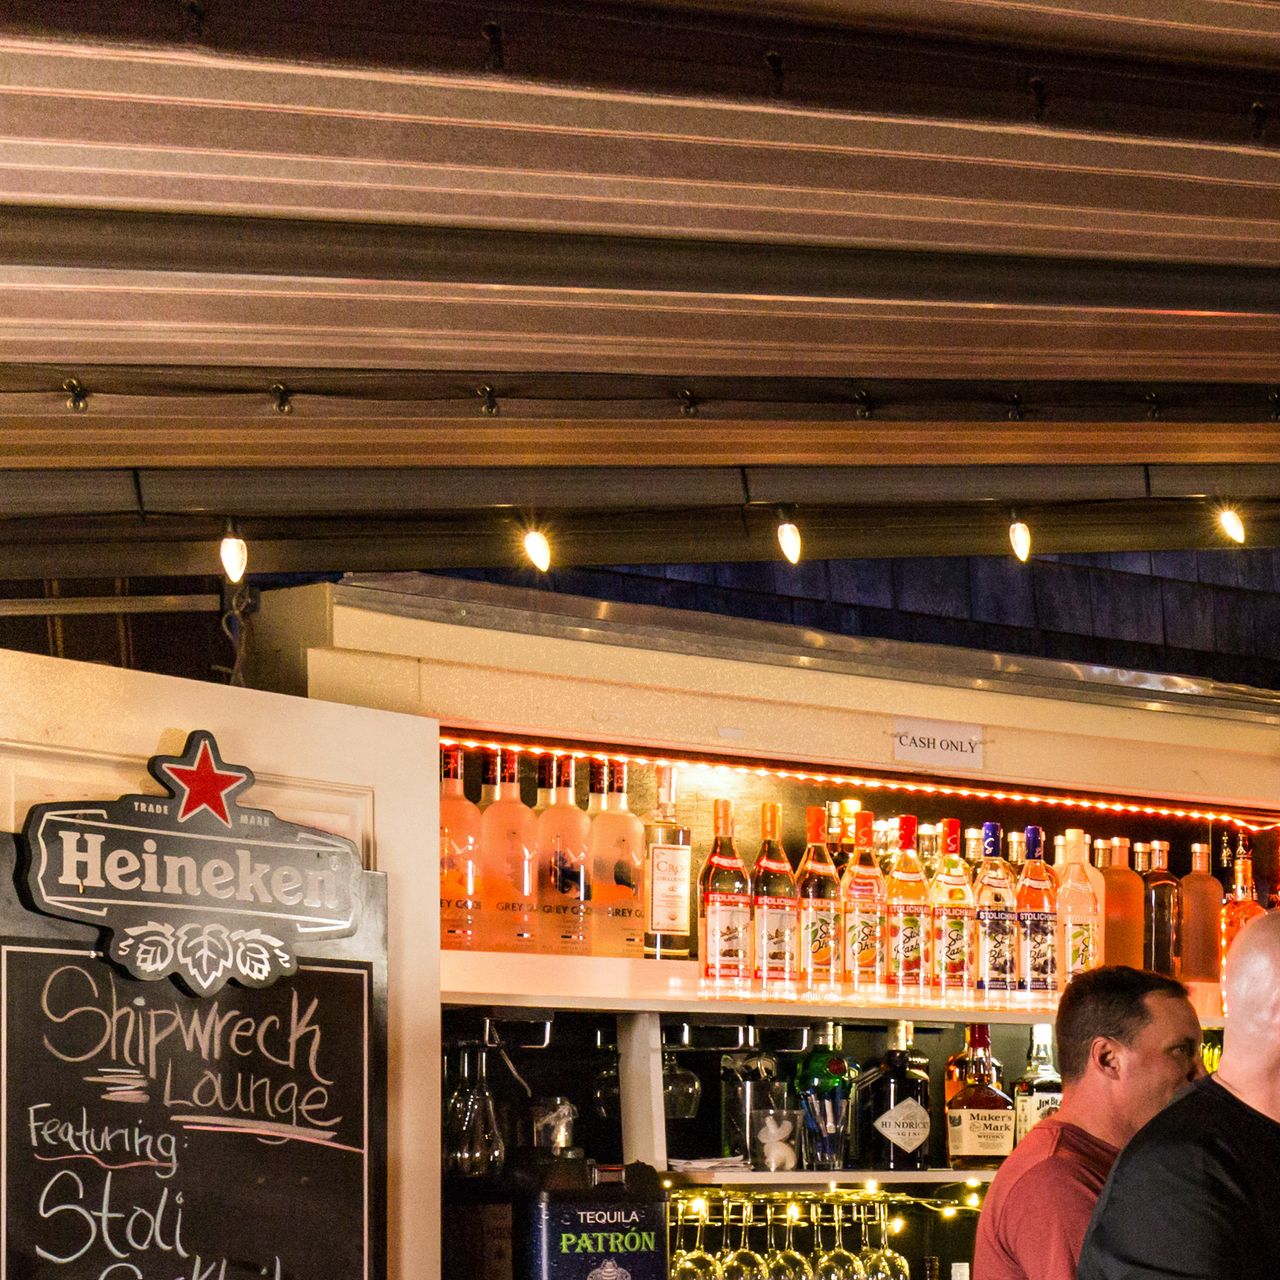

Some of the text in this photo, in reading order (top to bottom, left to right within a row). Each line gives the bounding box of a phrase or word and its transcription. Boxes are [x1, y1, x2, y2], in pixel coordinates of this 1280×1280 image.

[898, 734, 978, 754] CASH ONLY
[133, 801, 169, 815] TRADE
[58, 830, 340, 909] Heineken
[542, 904, 568, 915] GEY
[41, 965, 335, 1086] Shipwreck
[163, 1057, 344, 1145] Lounge
[969, 1112, 1012, 1122] Maker's
[982, 1122, 1012, 1132] Mark
[35, 1170, 190, 1264] Stoli
[577, 1211, 640, 1224] TEQUILA
[560, 1226, 656, 1254] PATRÓN
